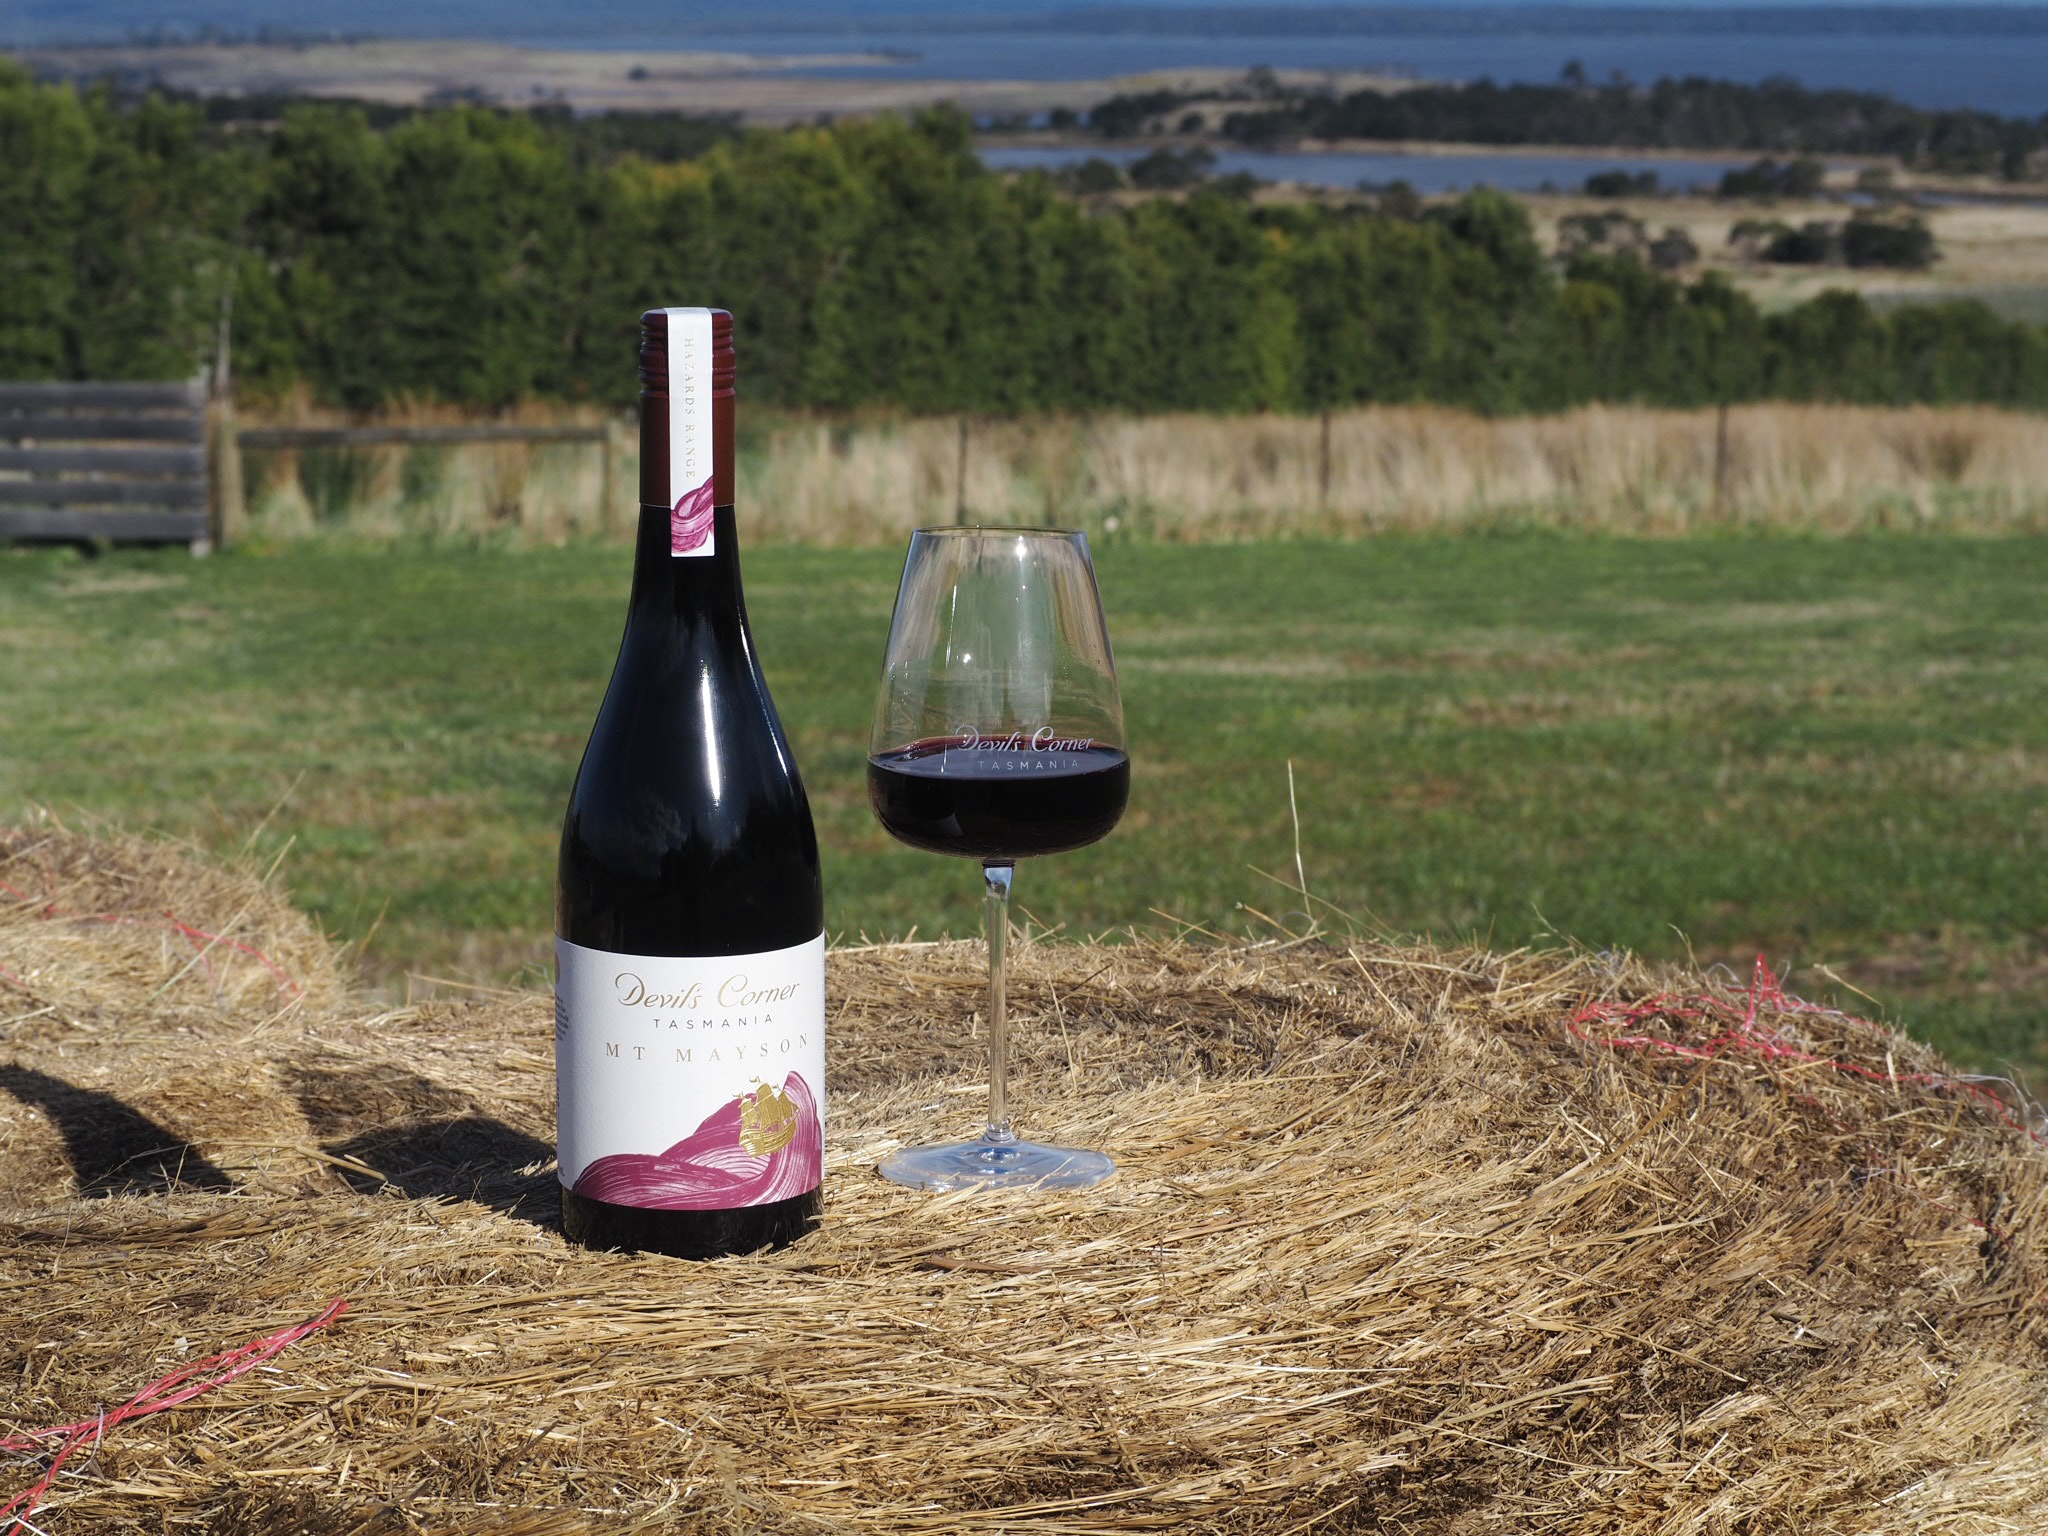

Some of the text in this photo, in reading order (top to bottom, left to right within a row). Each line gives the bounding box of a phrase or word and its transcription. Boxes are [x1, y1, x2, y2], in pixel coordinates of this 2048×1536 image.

[684, 338, 696, 479] HAZARDS RANGE
[955, 725, 1094, 752] Devil's Corner
[978, 759, 1079, 771] TASMANIA
[615, 972, 800, 1009] Devil's Corner
[653, 1014, 773, 1030] TASMANIA
[606, 1033, 808, 1063] MT MAYSON
